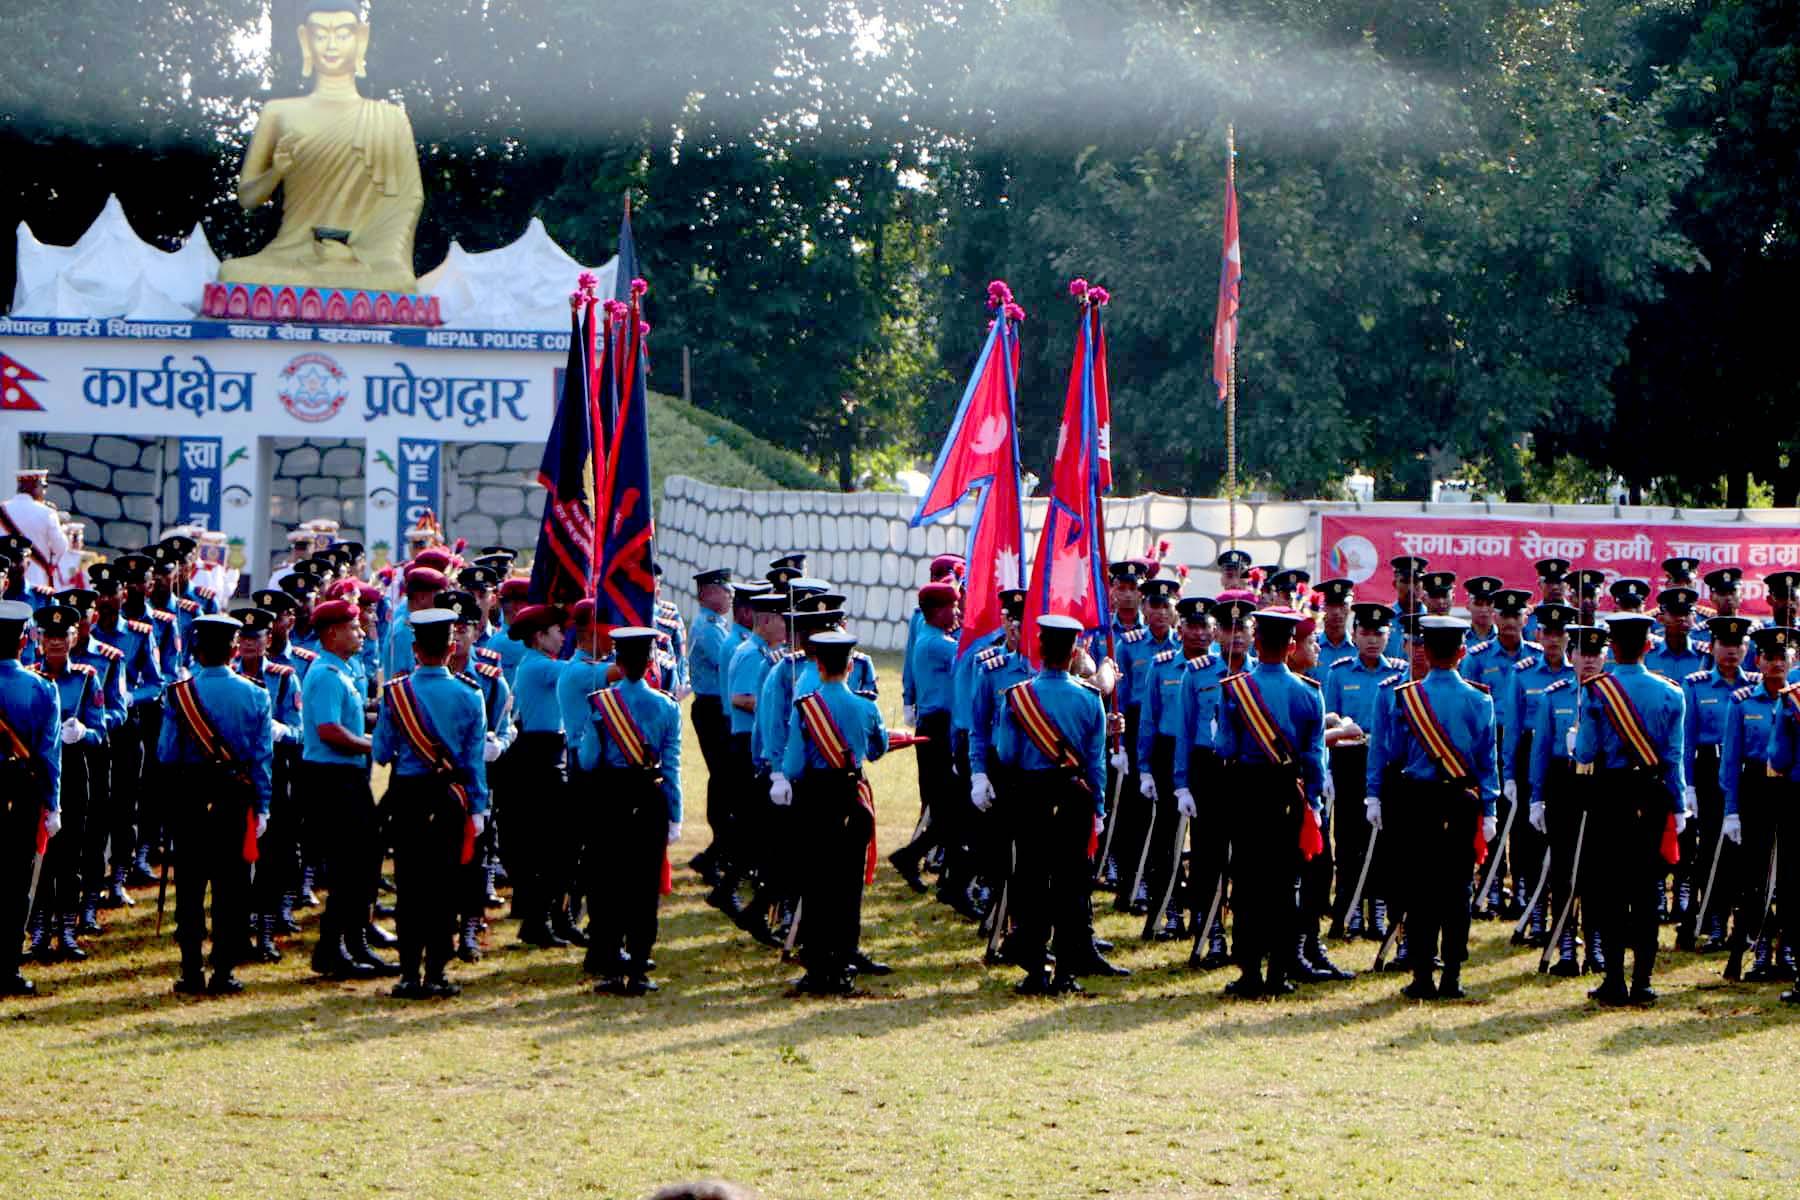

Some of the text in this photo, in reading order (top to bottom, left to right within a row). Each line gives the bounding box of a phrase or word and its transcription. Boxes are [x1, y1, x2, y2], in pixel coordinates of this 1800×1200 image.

[57, 318, 100, 336] प्रहरी
[107, 318, 193, 338] शिक्षालय
[276, 323, 313, 340] सेवा
[426, 331, 478, 347] NEPAL
[482, 333, 537, 348] POLICE
[82, 355, 256, 417] कार्यक्षेत्र
[363, 362, 532, 427] प्रवेशद्वार
[1520, 530, 1586, 559] सेवक
[1749, 542, 1800, 567] हाम्र
